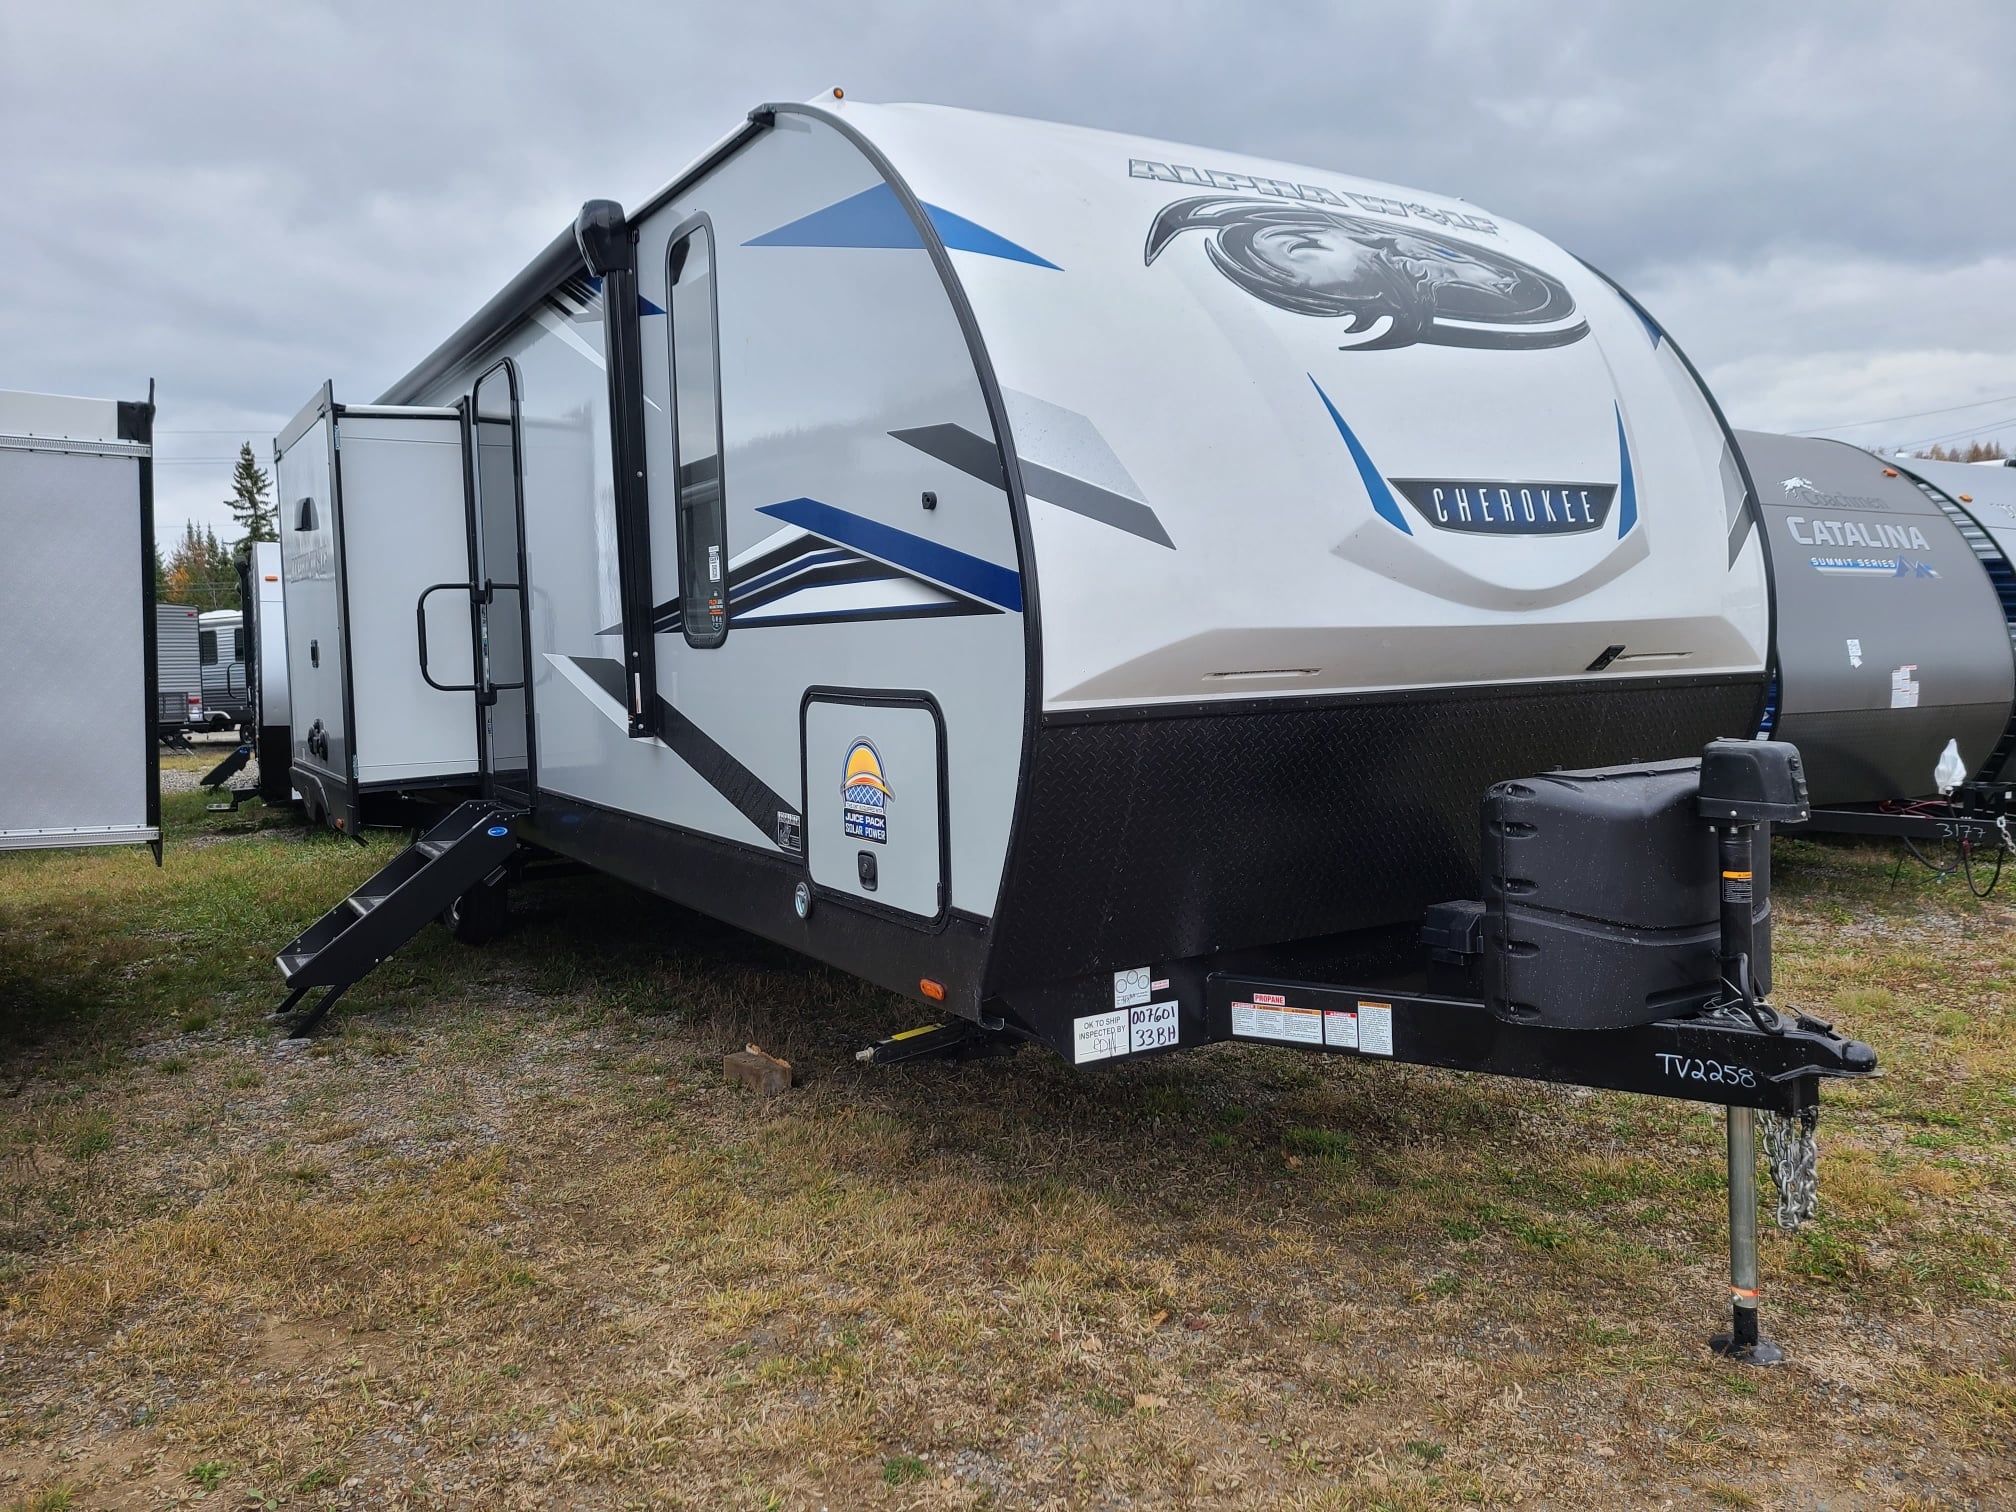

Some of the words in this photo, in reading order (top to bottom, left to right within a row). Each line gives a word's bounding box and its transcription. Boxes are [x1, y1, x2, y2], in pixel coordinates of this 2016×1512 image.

[1129, 158, 1348, 208] ALPHA
[1433, 488, 1595, 523] CHEROKEE
[1786, 516, 1931, 550] CATALINA
[1810, 557, 1852, 567] SUMMIT
[1857, 558, 1896, 568] SERIES
[845, 812, 864, 823] JUICE
[865, 816, 885, 827] PACK
[845, 823, 863, 835] SOLAR
[865, 827, 885, 840] POWER
[1936, 823, 1986, 839] 3177
[1255, 994, 1284, 1004] PROPANE
[1083, 1022, 1094, 1030] OK
[1095, 1019, 1104, 1027] TO
[1105, 1016, 1121, 1025] SHIP
[1131, 1005, 1175, 1025] 007601
[1079, 1027, 1116, 1040] INSPECTED
[1117, 1025, 1126, 1033] BY
[1655, 1053, 1757, 1088] TV2258
